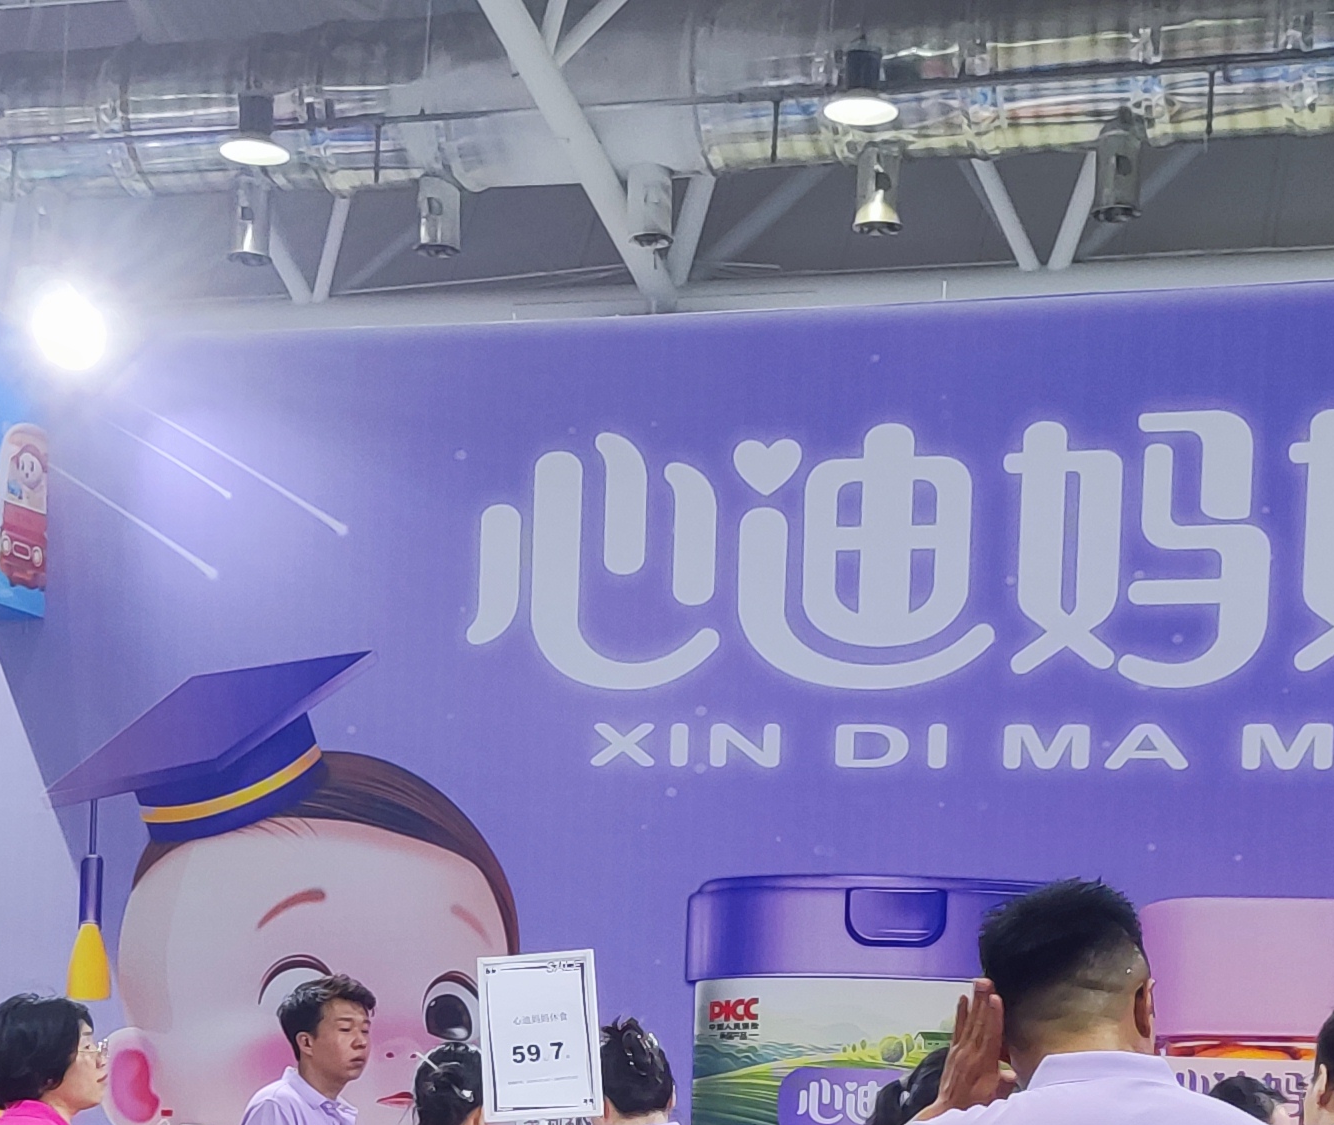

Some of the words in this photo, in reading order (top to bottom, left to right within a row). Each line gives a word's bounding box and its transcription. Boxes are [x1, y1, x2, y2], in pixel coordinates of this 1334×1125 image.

[590, 721, 782, 768] XIN
[834, 722, 948, 769] DI
[1002, 722, 1188, 770] MA
[709, 998, 759, 1022] PICC
